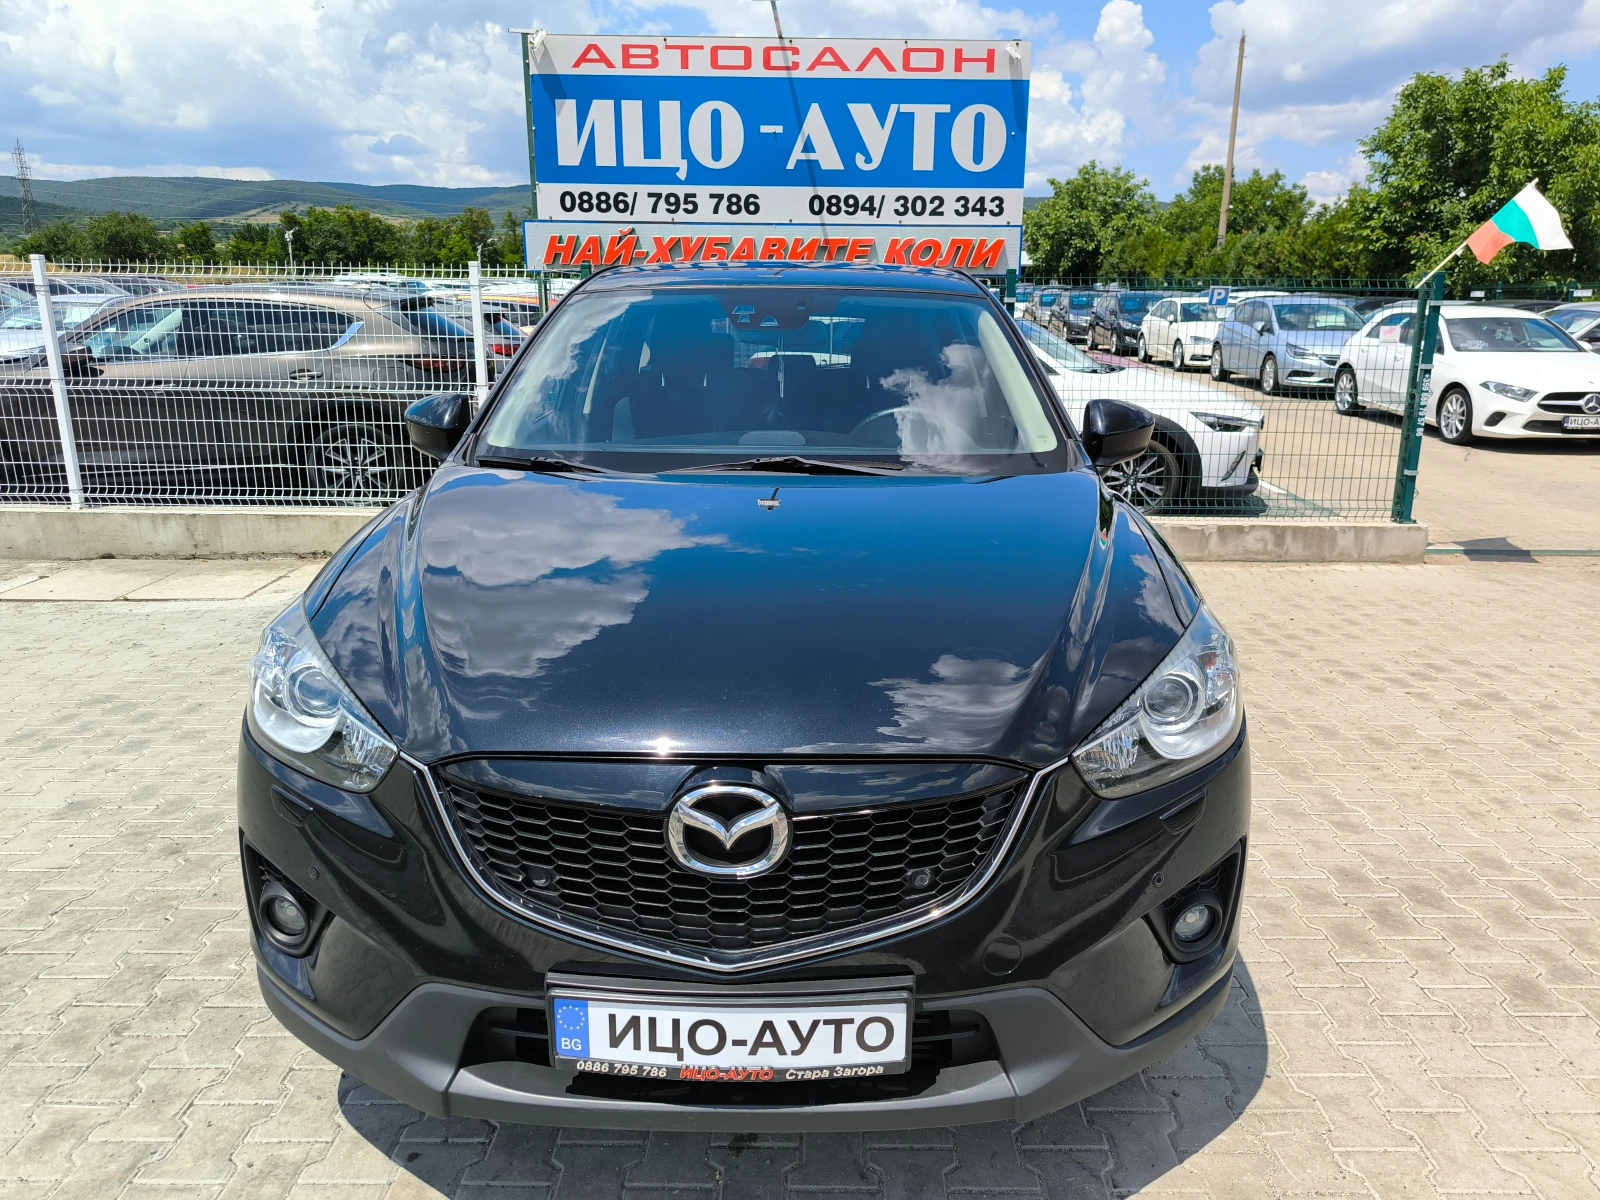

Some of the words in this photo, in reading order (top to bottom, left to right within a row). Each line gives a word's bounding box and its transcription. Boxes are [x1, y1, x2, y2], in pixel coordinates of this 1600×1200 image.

[571, 43, 996, 73] АВТОСАЛОН
[559, 191, 638, 216] 0886/
[647, 193, 699, 214] 795
[708, 193, 760, 215] 786
[808, 194, 886, 219] 0894/
[893, 195, 946, 217] 302
[953, 196, 1005, 217] 343
[883, 237, 1006, 268] КОЛИ
[561, 1037, 582, 1051] BG
[608, 1013, 895, 1062] ИЦО-АУТО
[576, 1060, 609, 1073] 0886
[613, 1063, 638, 1076] 795
[642, 1066, 667, 1078] 786
[679, 1066, 775, 1082] ИЦО-АУТО
[785, 1067, 830, 1080] Стара
[833, 1065, 884, 1078] Загора
